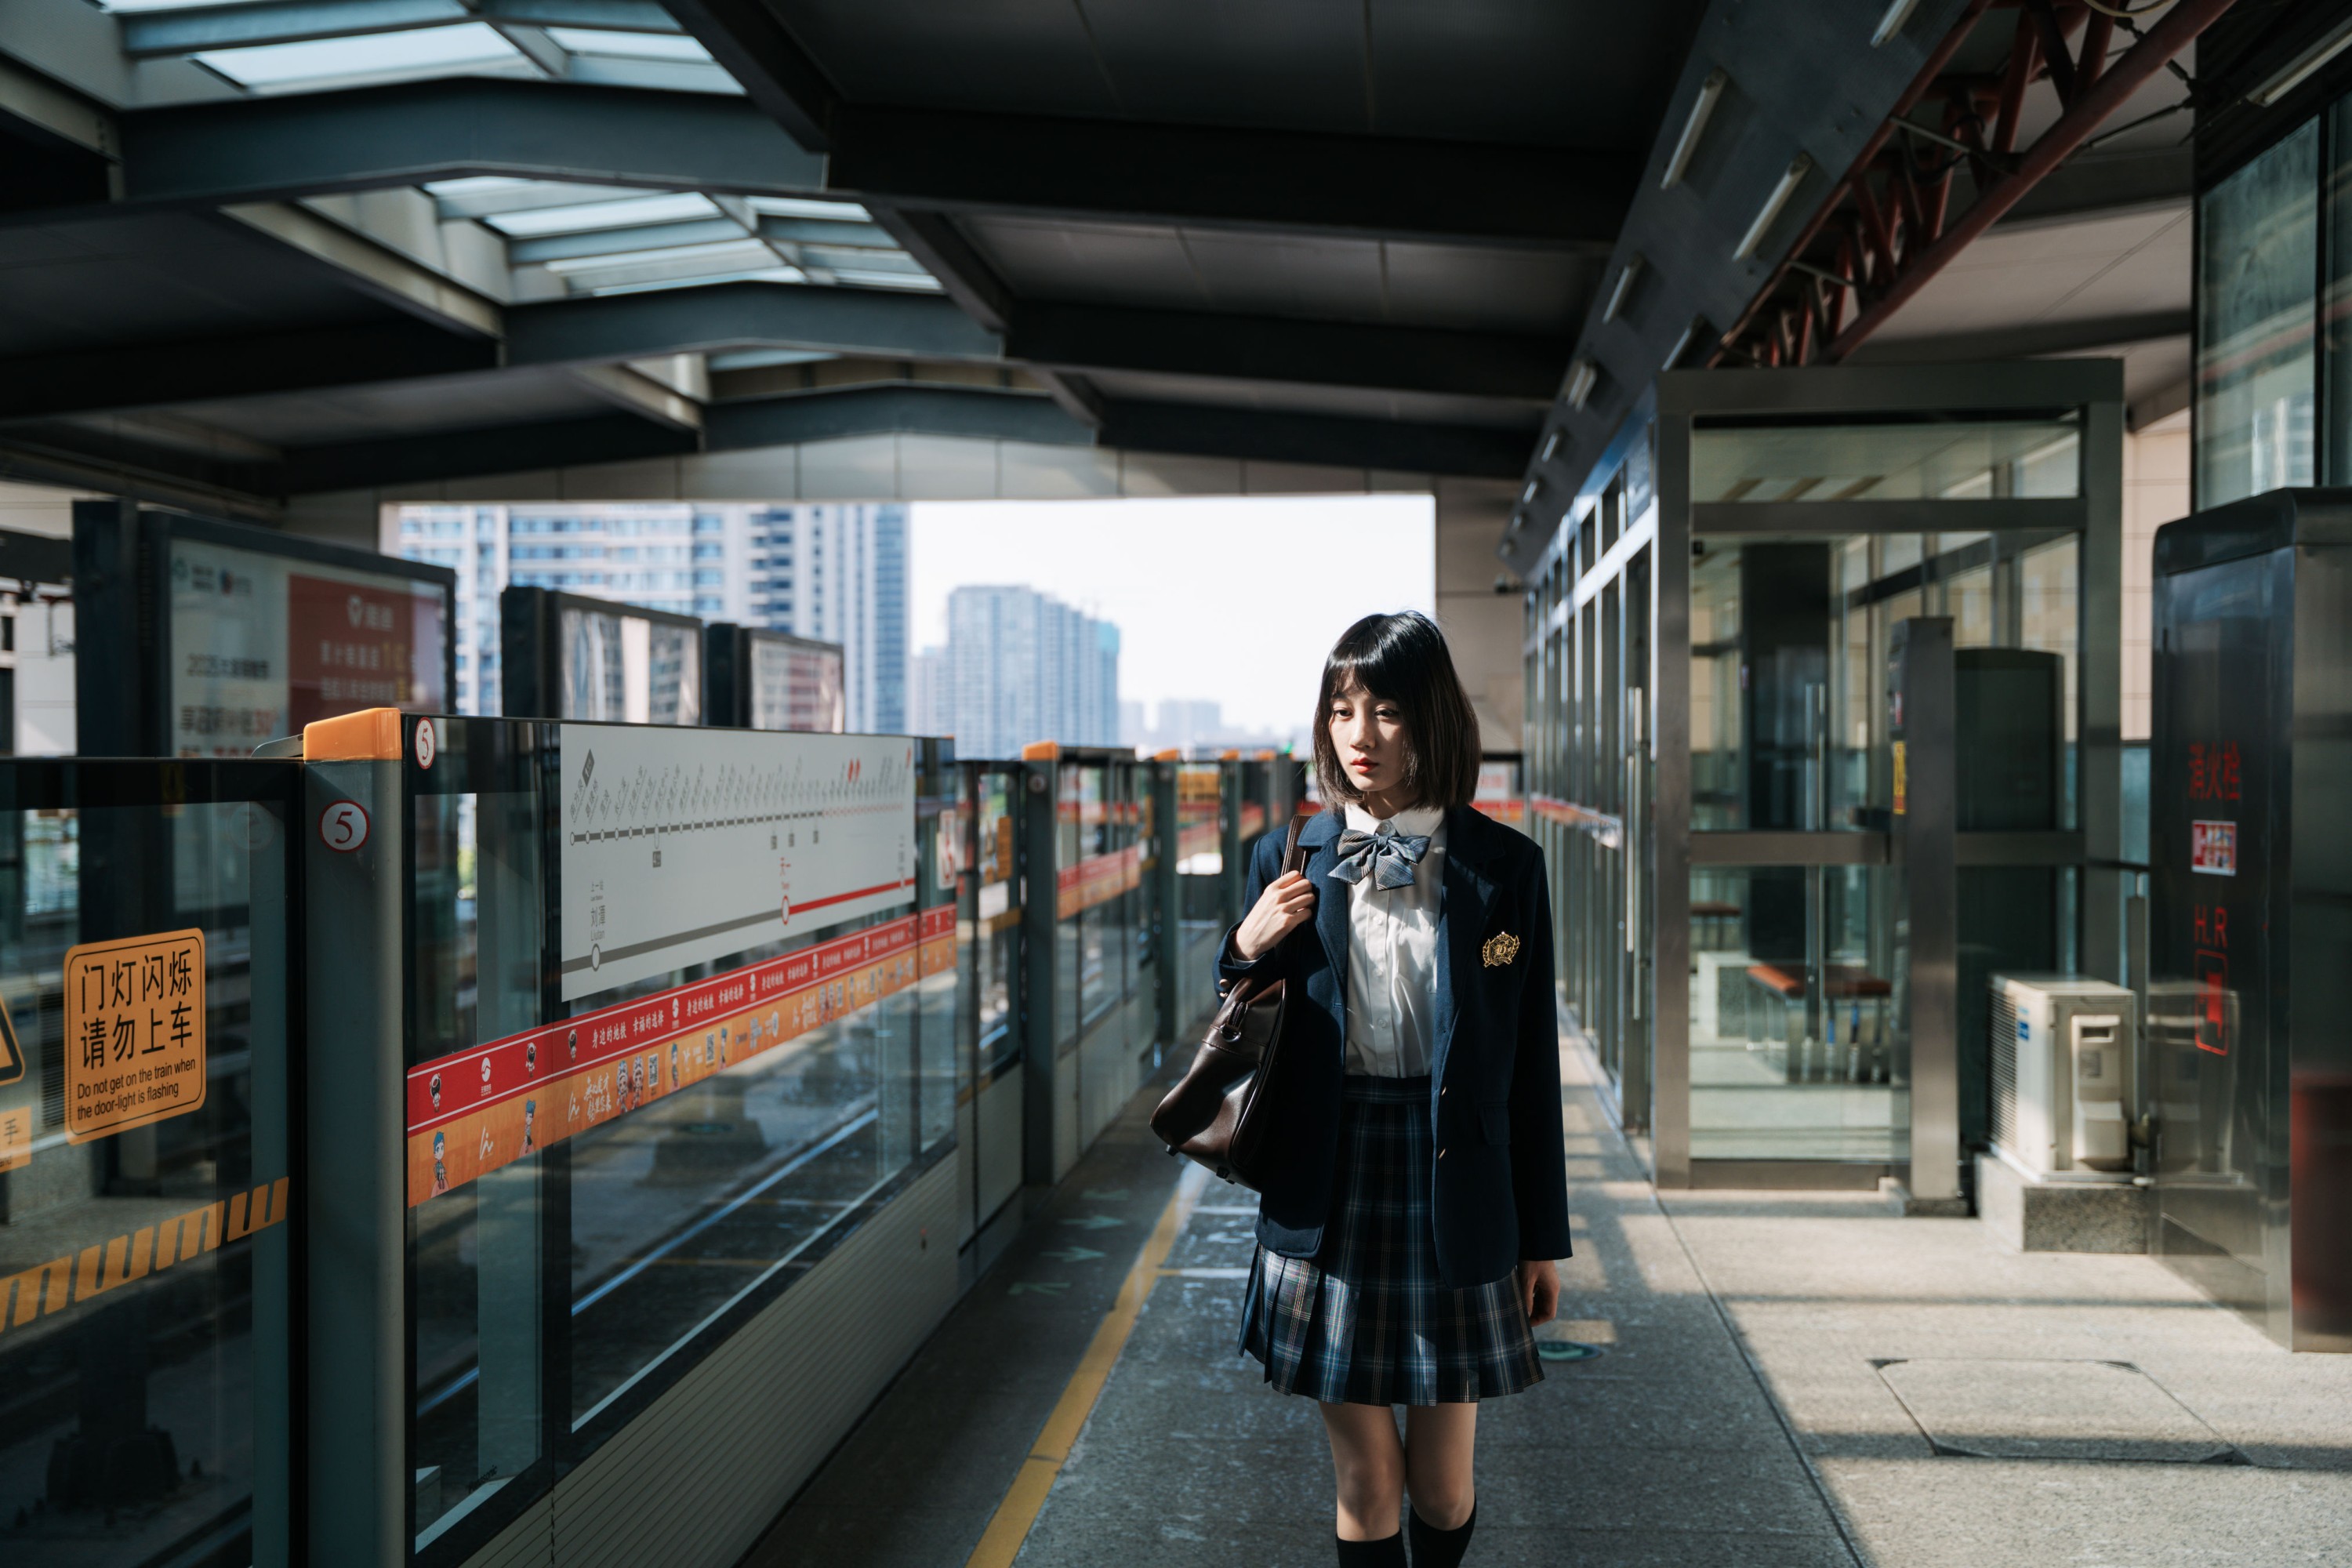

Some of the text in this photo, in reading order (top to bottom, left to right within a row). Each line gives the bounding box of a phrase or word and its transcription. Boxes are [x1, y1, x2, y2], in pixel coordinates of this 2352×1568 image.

[422, 728, 430, 760] 5
[335, 811, 353, 844] 5
[81, 949, 193, 1014] 门灯闪烁
[80, 1000, 193, 1070] 请勿上车
[592, 1009, 665, 1049] 身边的地铁 幸福的选择
[77, 1058, 196, 1099] Do not get on the train when
[77, 1082, 180, 1120] the door-light is flashing
